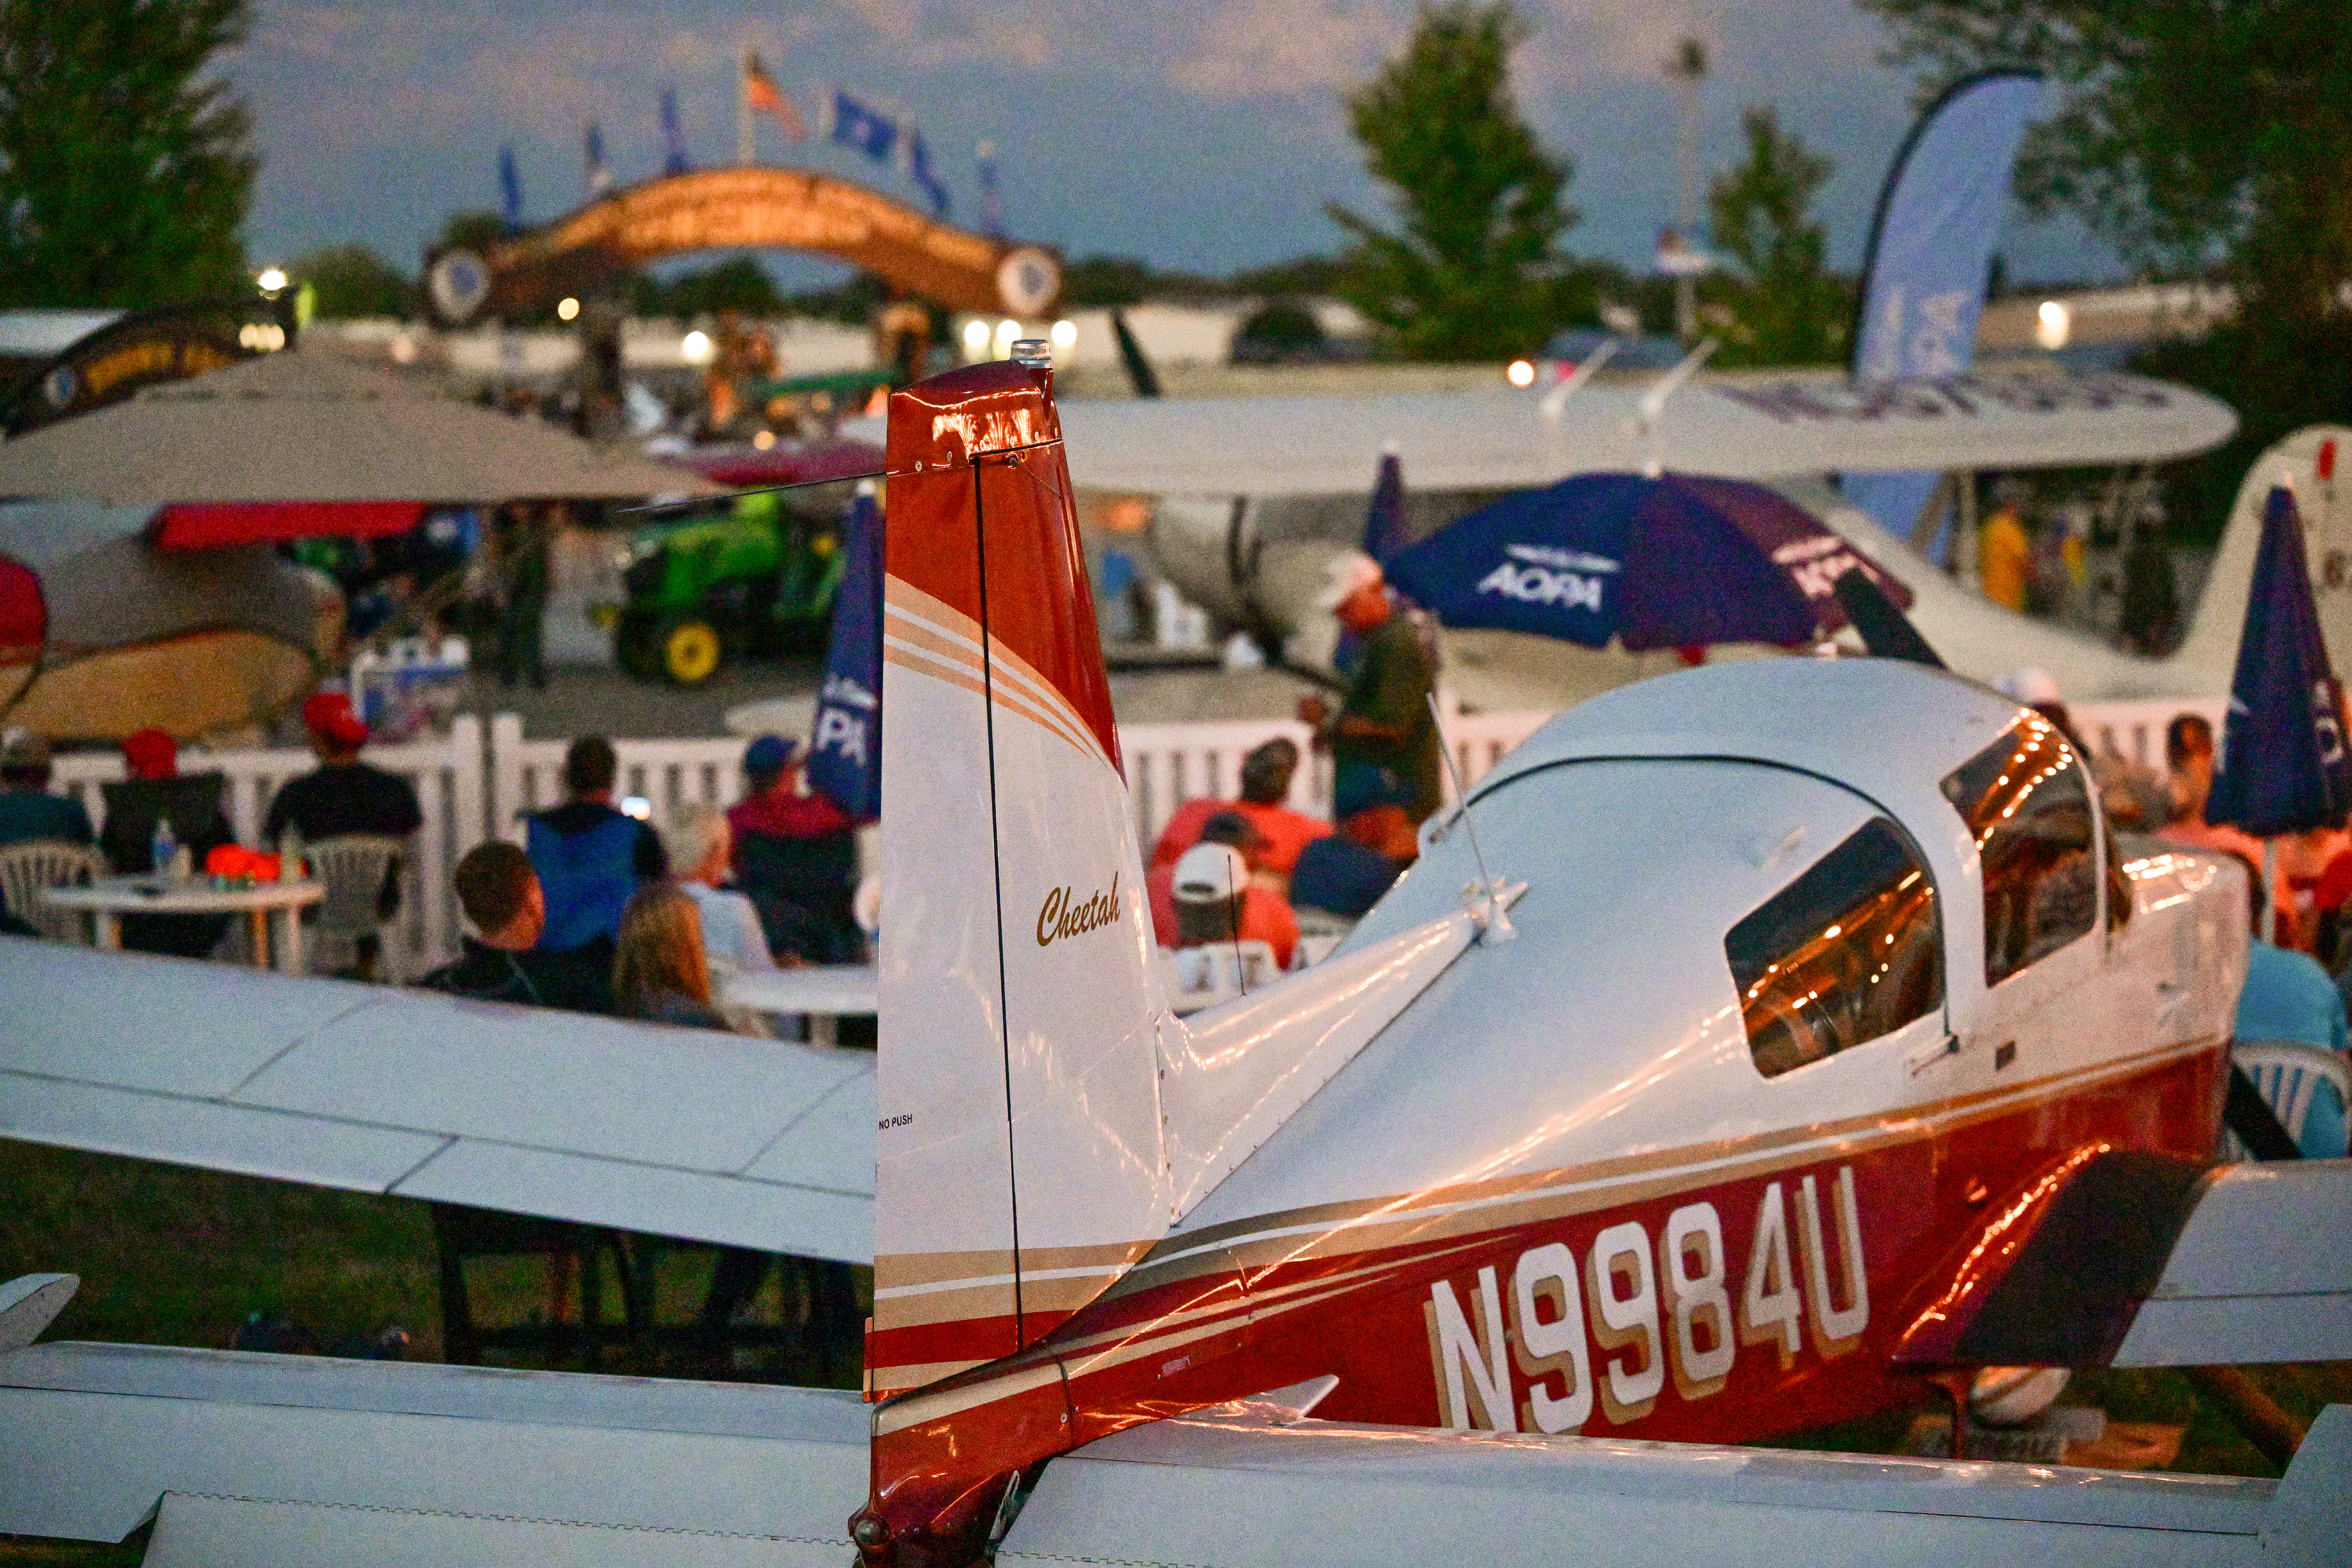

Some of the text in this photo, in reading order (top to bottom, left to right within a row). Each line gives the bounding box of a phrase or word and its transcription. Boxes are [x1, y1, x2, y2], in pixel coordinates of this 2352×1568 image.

[1037, 870, 1121, 947] Cheetah
[878, 1113, 913, 1131] NO PUSH
[1425, 1164, 1870, 1435] N9984U
